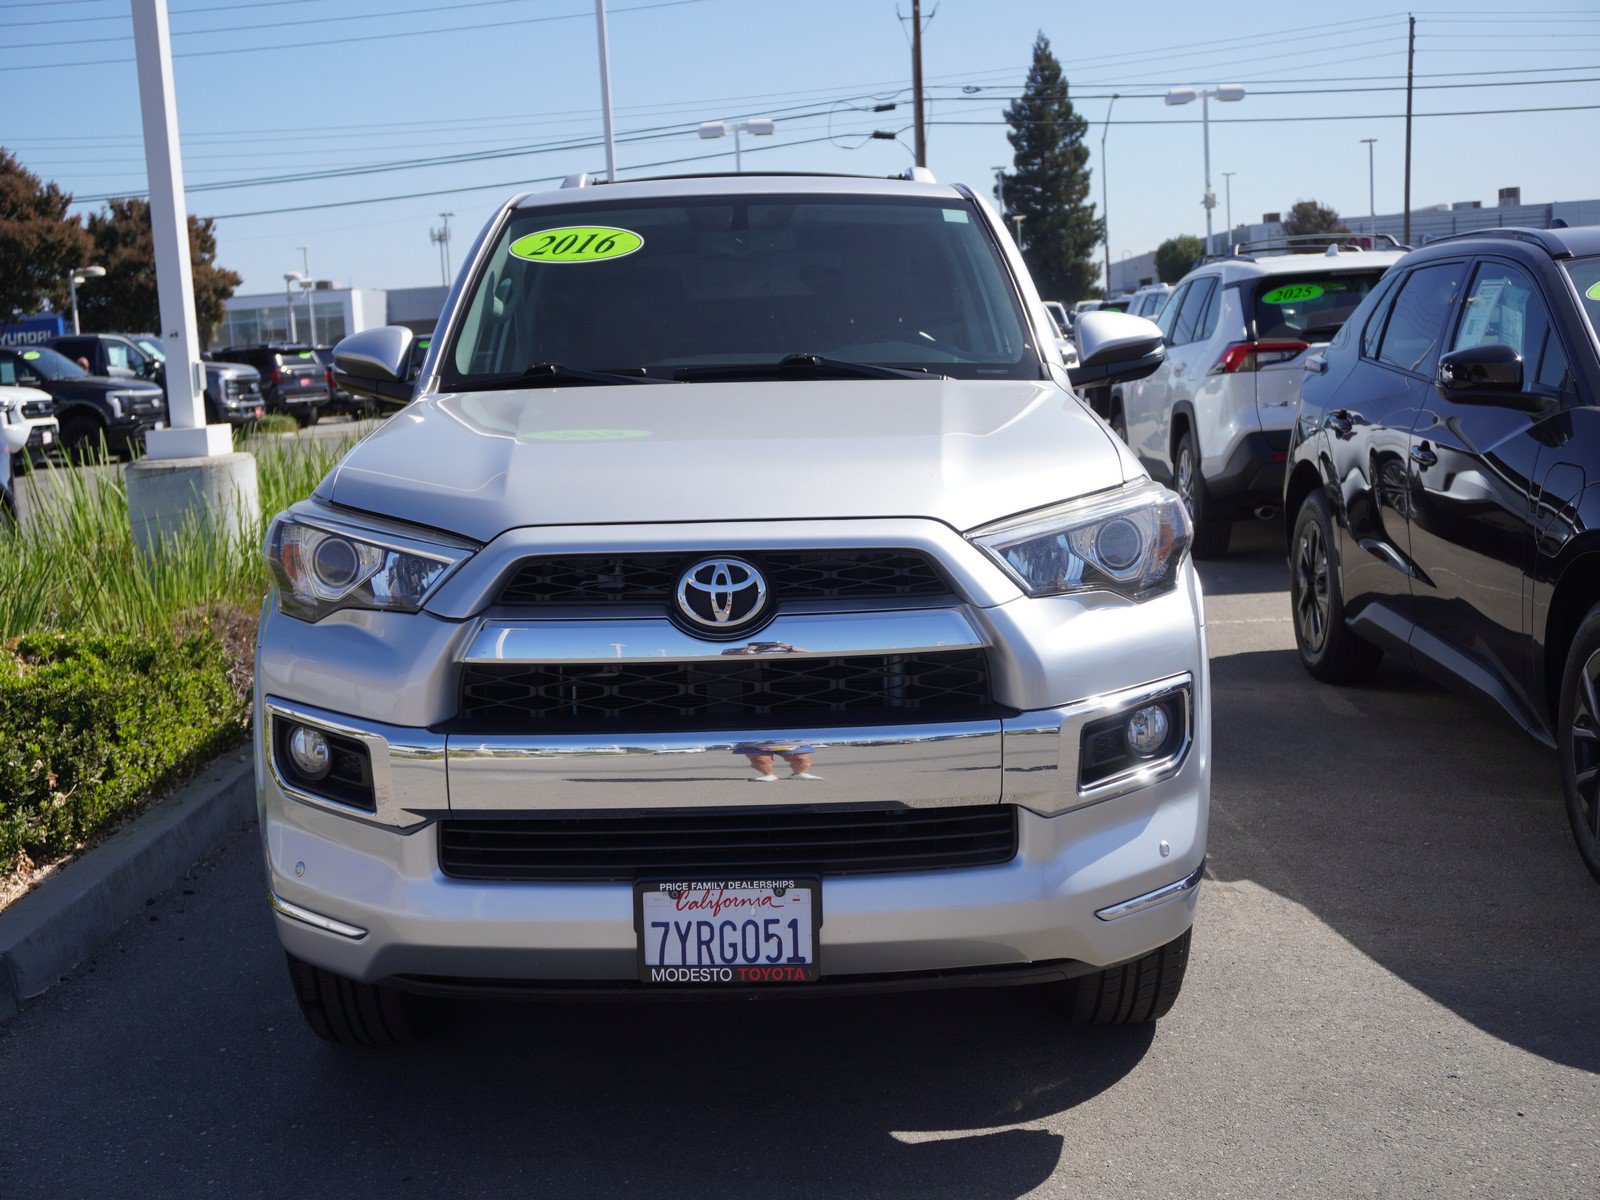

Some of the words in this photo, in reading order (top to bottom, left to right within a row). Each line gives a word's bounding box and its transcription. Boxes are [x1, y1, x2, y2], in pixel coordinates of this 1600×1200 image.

[527, 233, 624, 256] 2016
[1273, 286, 1314, 302] 2025
[659, 883, 689, 892] PRICE
[691, 881, 725, 891] FAMILY
[728, 880, 795, 890] DEALERSHIPS
[675, 888, 785, 917] California
[650, 918, 807, 966] 7YRG051
[651, 968, 732, 982] MODESTO
[737, 967, 806, 981] TOYOTA
